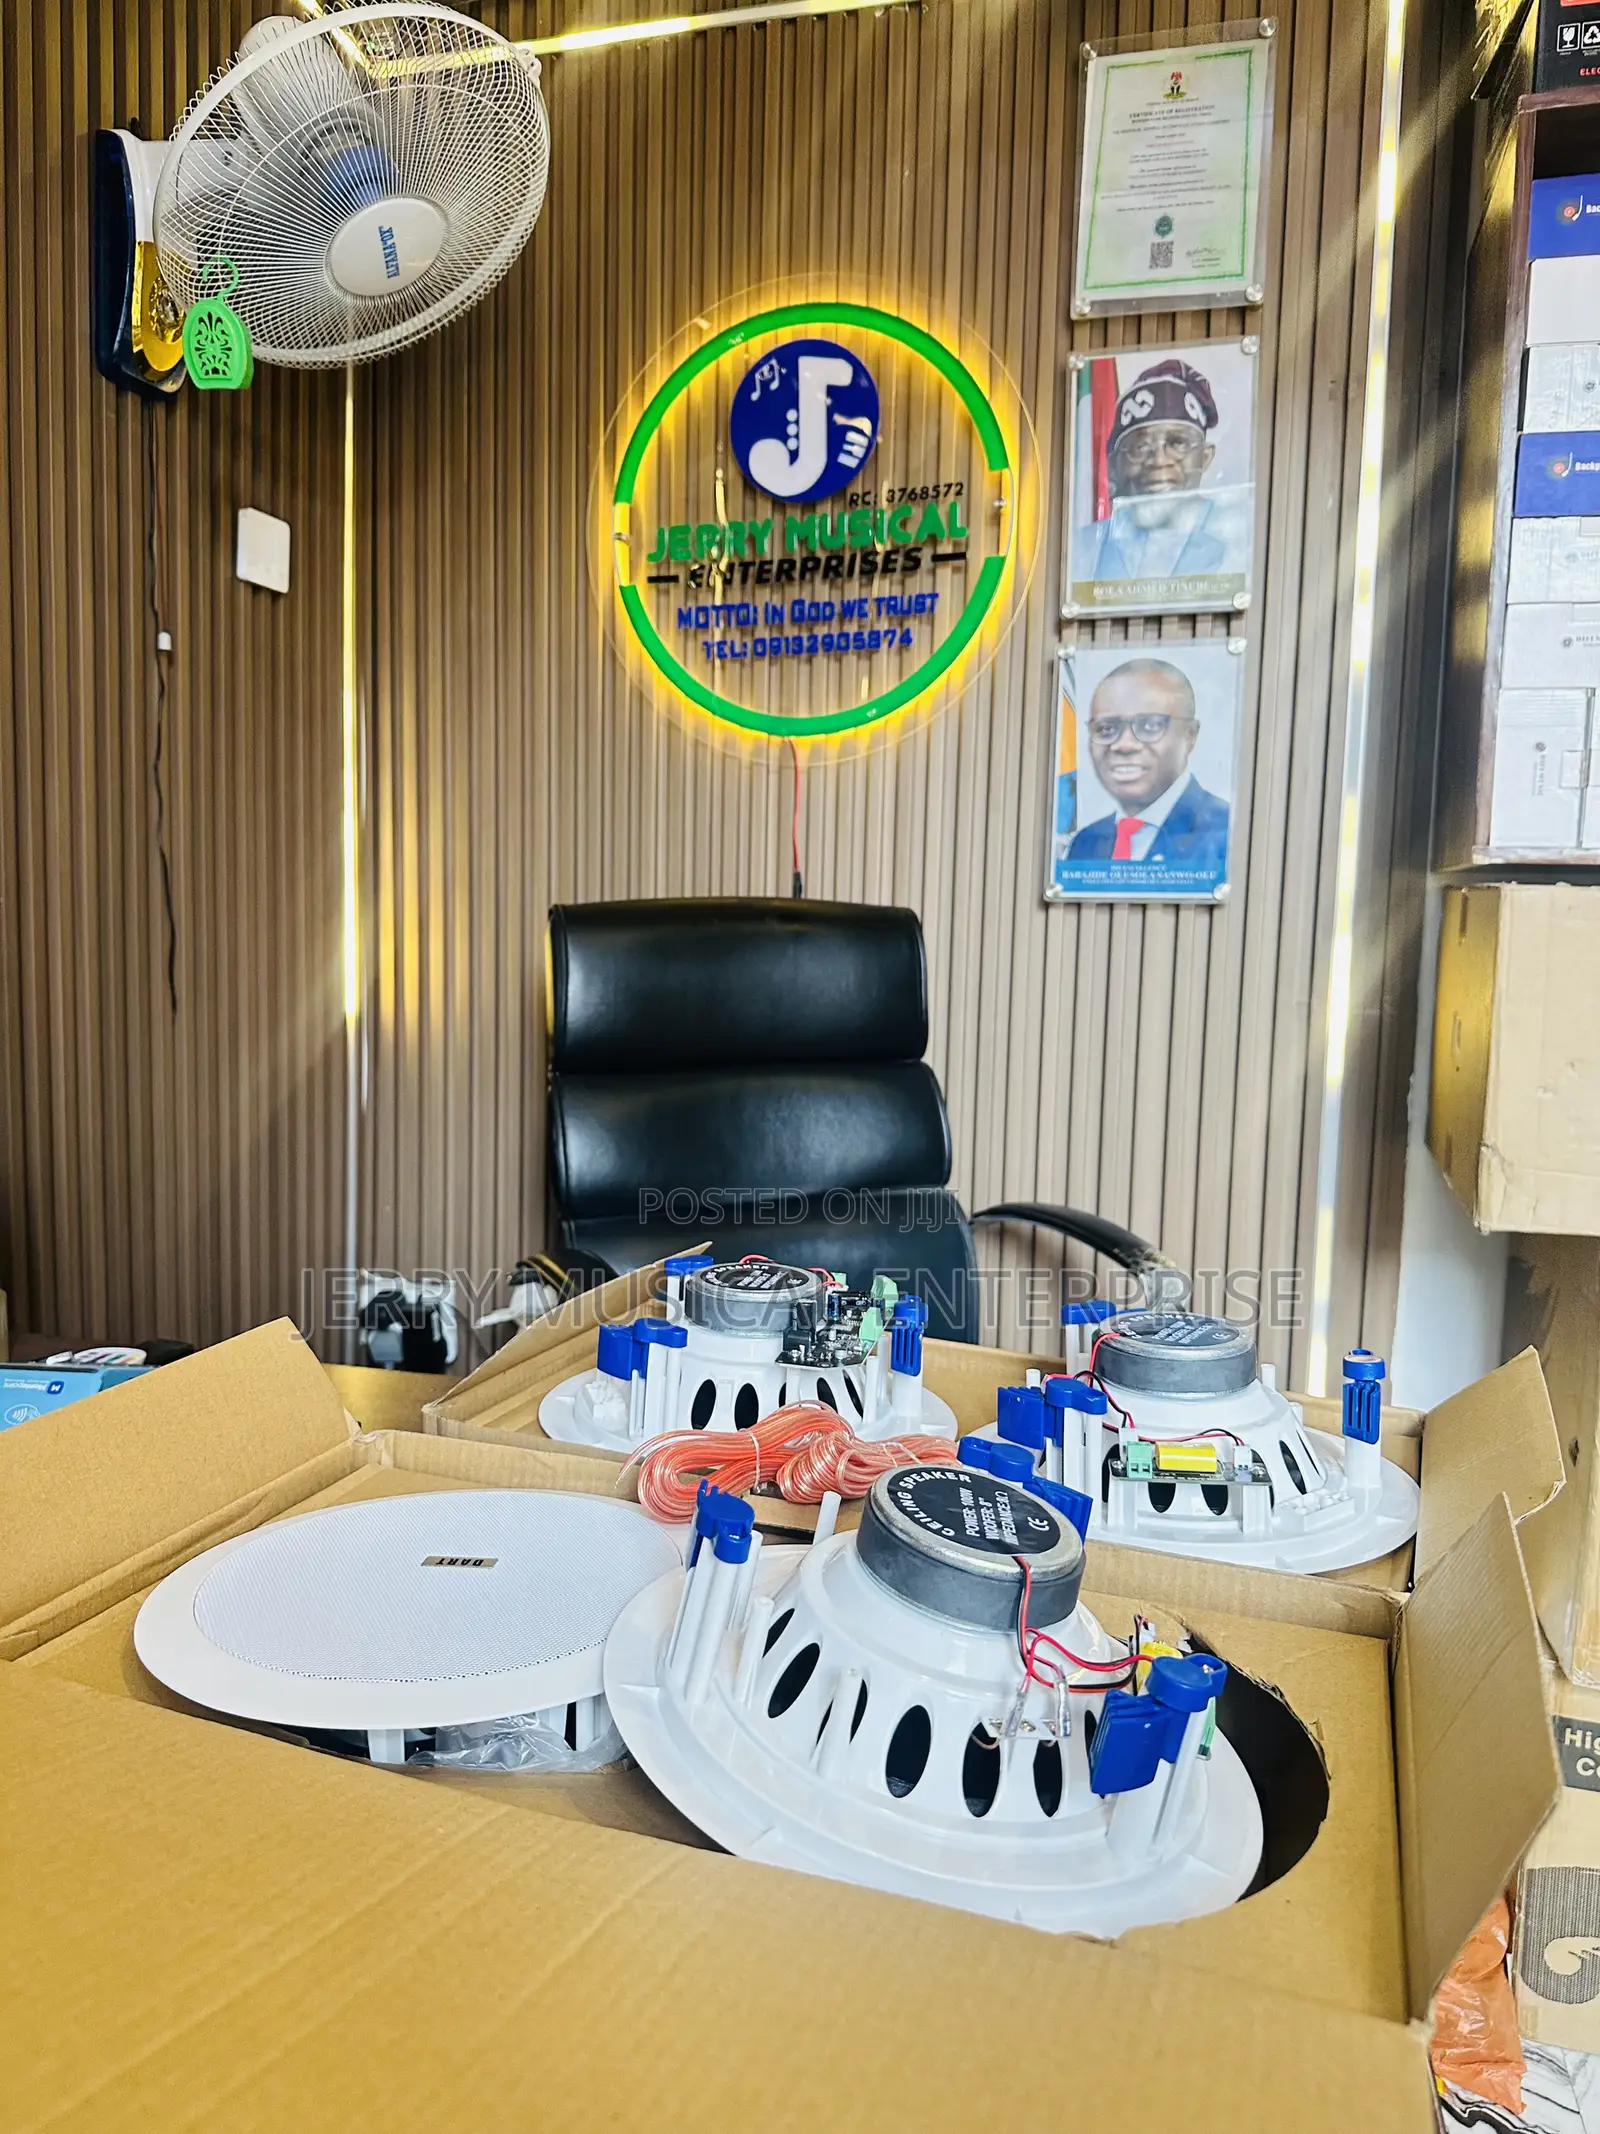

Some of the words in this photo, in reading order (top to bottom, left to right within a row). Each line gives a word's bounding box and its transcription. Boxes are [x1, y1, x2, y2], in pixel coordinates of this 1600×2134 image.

[849, 491, 877, 508] RC:
[886, 482, 964, 503] 3768572
[647, 518, 774, 563] JERRY
[785, 501, 968, 552] MUSICAL
[688, 547, 922, 588] ENTERPRISES
[677, 603, 758, 629] MOTTO:
[840, 598, 868, 620] WE
[873, 593, 939, 616] TRUST
[702, 639, 748, 660] TEL:
[753, 628, 913, 657] 09132905874
[899, 1471, 971, 1489] SPEAKER
[897, 1491, 955, 1536] CEILING
[436, 1558, 484, 1566] DART
